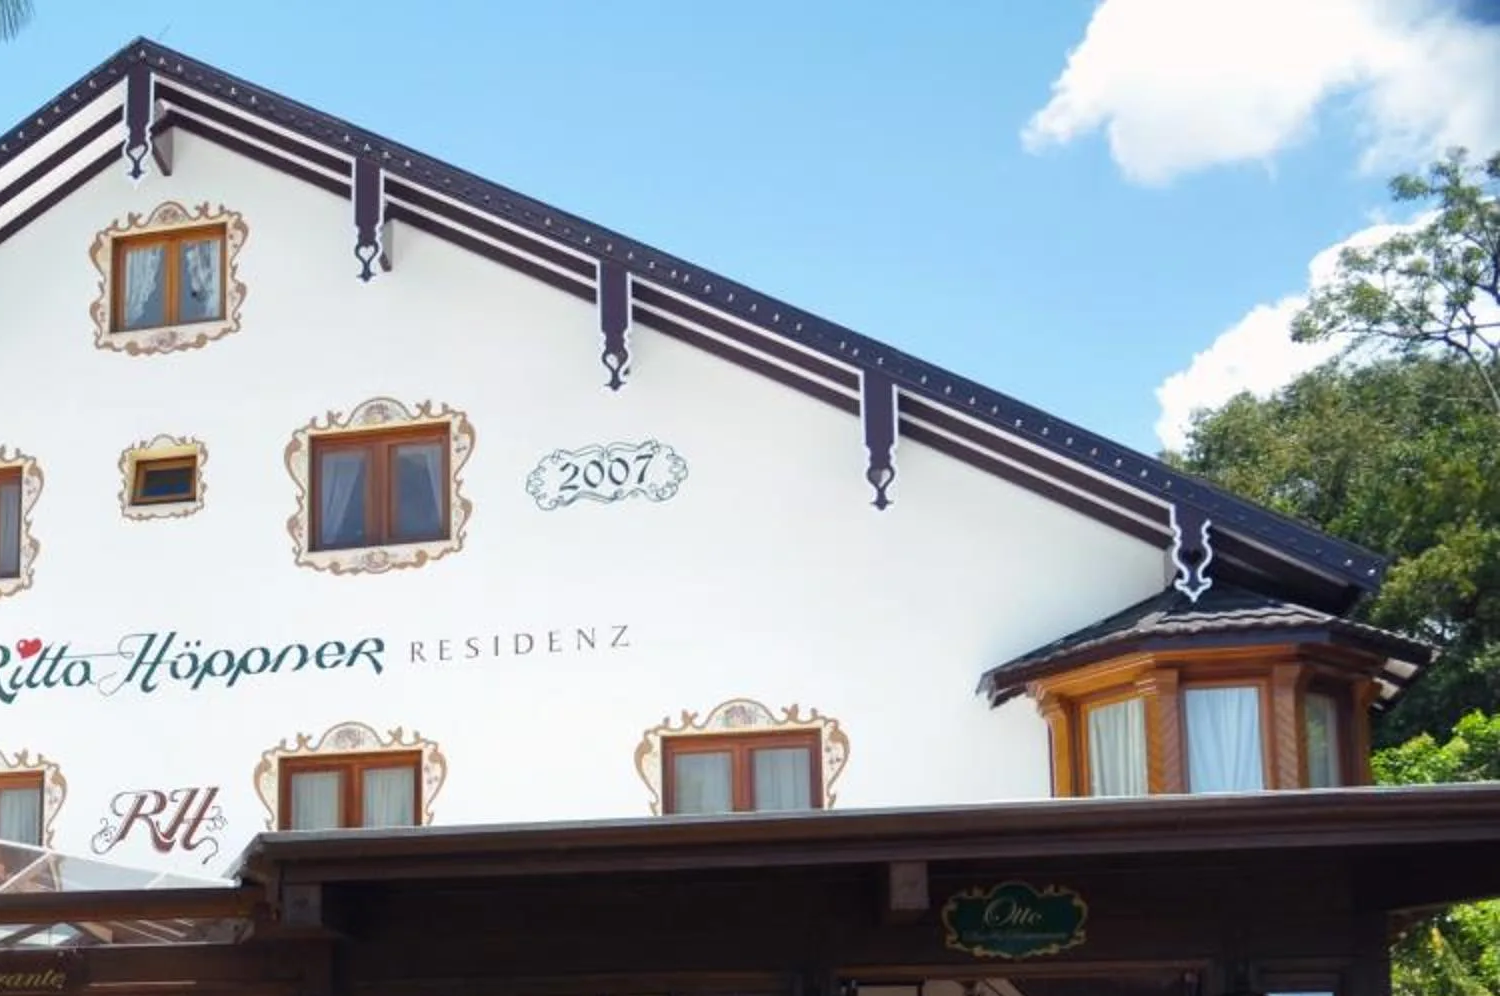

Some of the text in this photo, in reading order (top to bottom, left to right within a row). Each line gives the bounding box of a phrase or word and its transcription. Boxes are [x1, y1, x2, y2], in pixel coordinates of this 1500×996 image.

[558, 453, 654, 492] 2007
[98, 631, 386, 697] Höppner
[409, 624, 631, 664] RESIDENZ
[90, 786, 228, 865] RH
